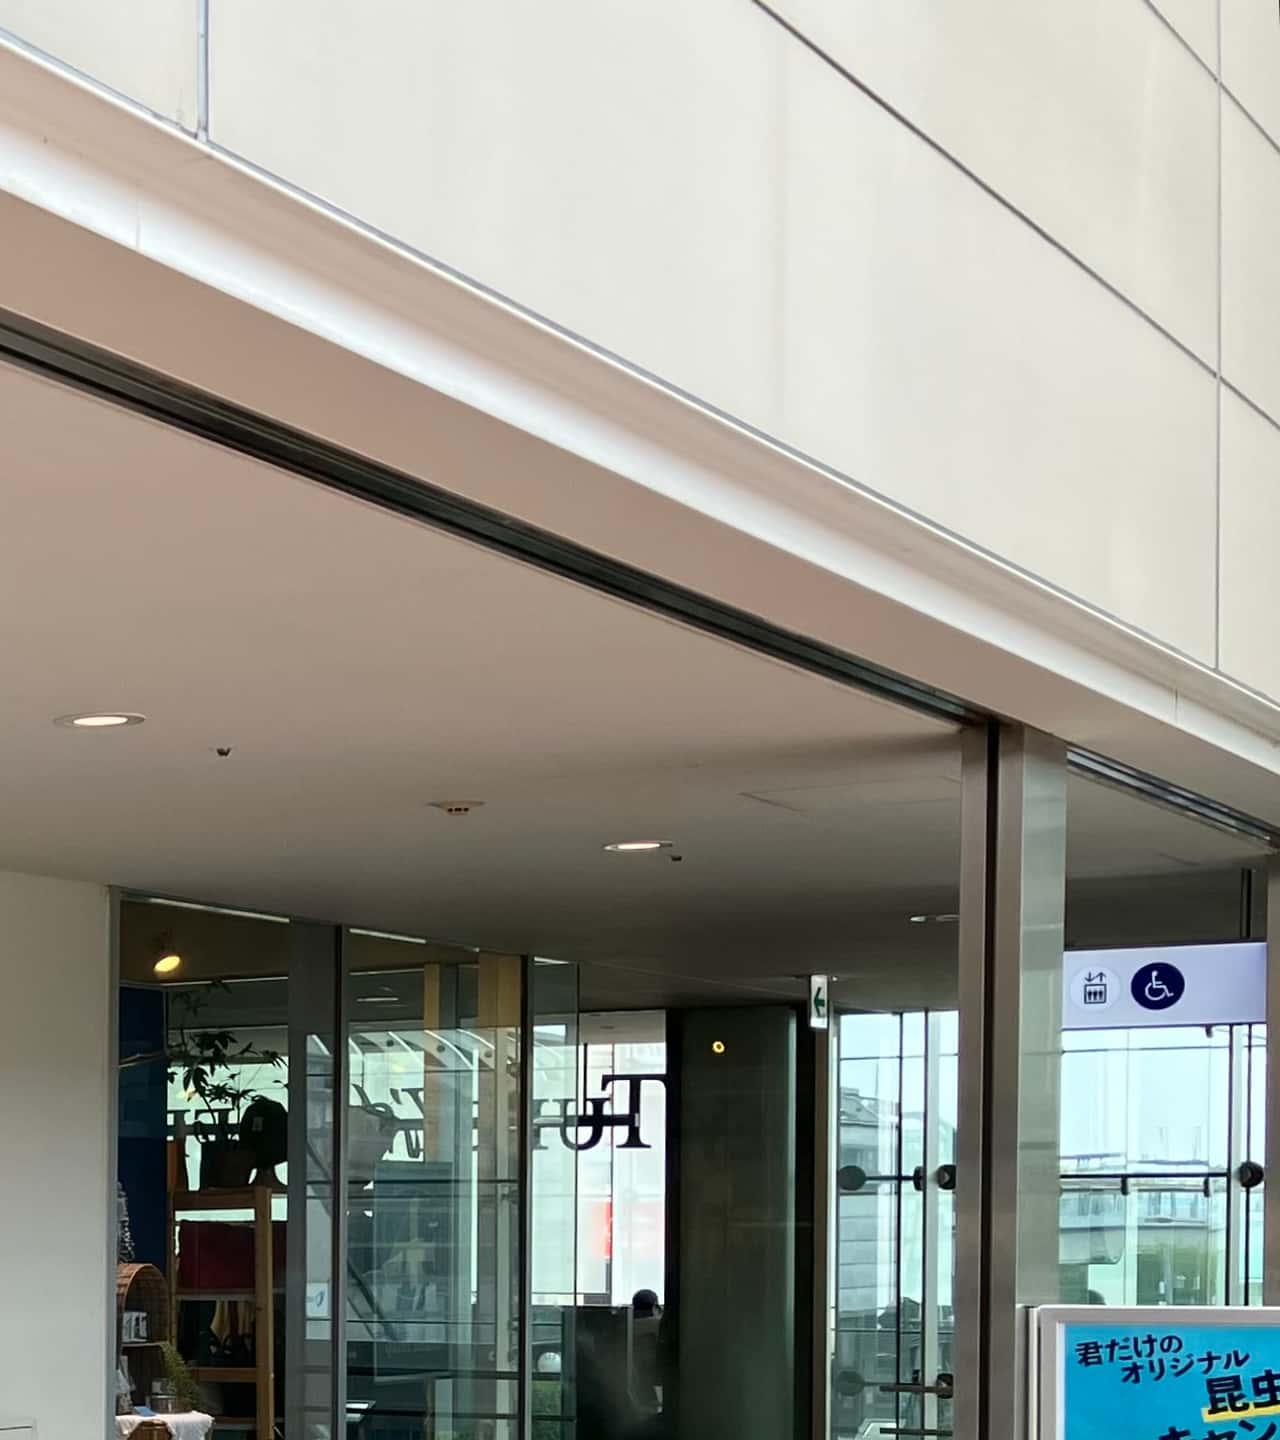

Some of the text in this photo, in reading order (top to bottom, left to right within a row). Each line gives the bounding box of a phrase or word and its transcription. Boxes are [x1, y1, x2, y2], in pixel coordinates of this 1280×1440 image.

[1075, 1334, 1184, 1368] 君だけの
[1121, 1349, 1250, 1384] オリジナル
[1206, 1369, 1280, 1415] 昆虫
